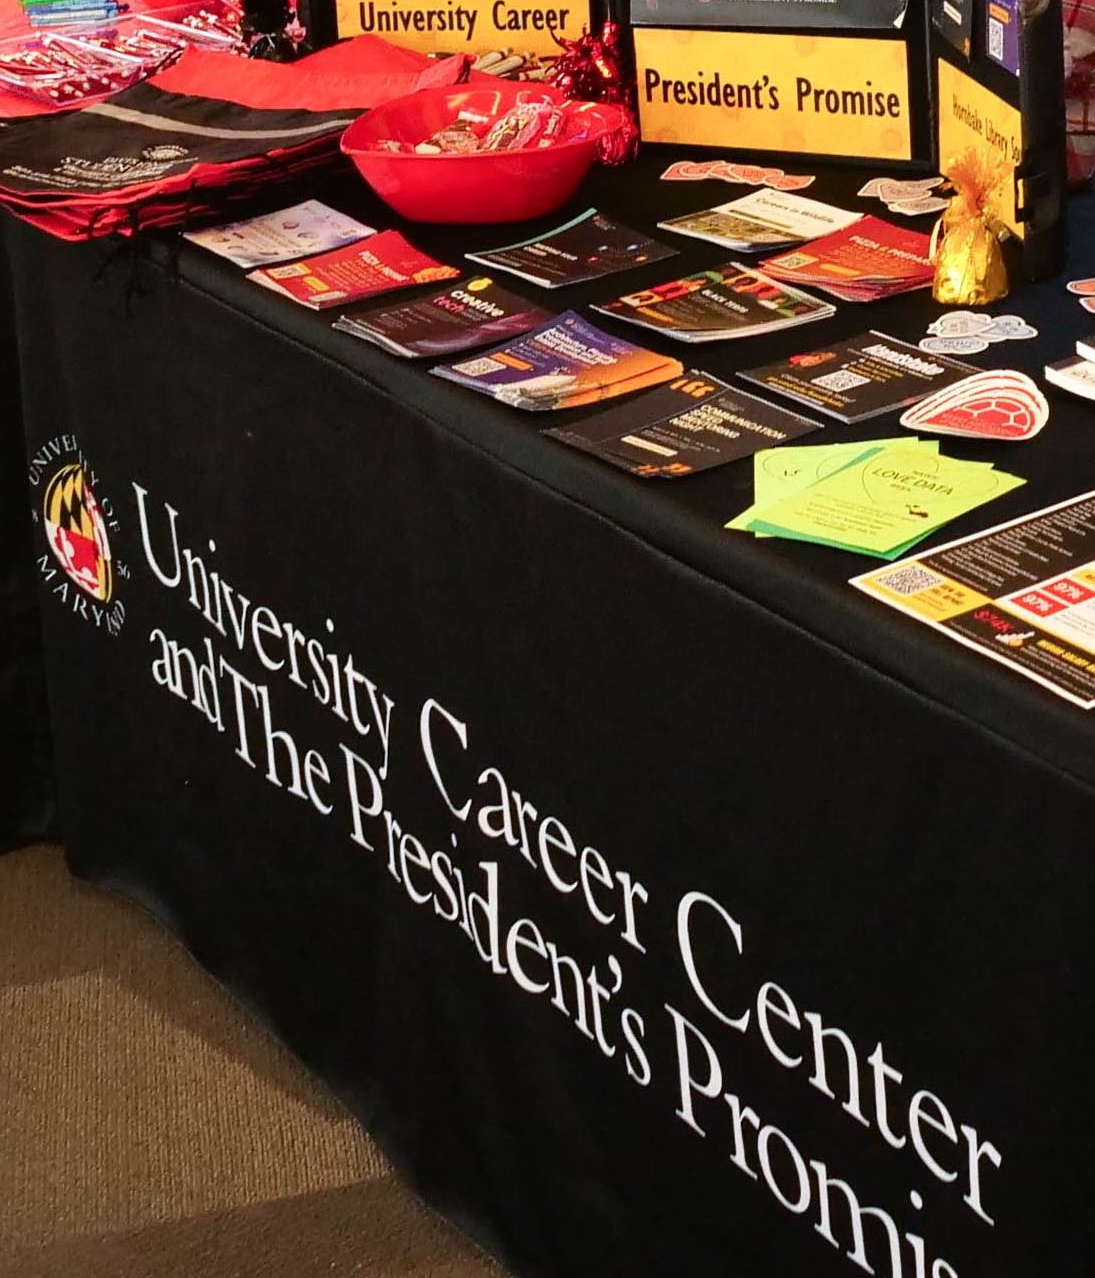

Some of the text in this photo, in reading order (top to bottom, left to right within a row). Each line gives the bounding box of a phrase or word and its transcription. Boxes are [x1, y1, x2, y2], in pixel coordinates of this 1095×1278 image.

[359, 0, 570, 41] University Career
[644, 67, 901, 118] President's Promise
[952, 92, 983, 136] Hornbake
[986, 116, 1009, 160] Library
[887, 247, 932, 266] PREPAR
[433, 295, 466, 314] tech
[450, 290, 505, 318] creative
[701, 288, 728, 303] BLACK
[724, 300, 749, 314] TERPS
[861, 343, 946, 377] Handshake
[700, 404, 788, 440] COMMUNICATION
[872, 467, 955, 496] LOVE DATA
[1021, 593, 1054, 612] 97%
[1053, 581, 1084, 600] 97%
[132, 481, 1002, 1226] University Career Center
[149, 627, 959, 1278] and The President's Promi
